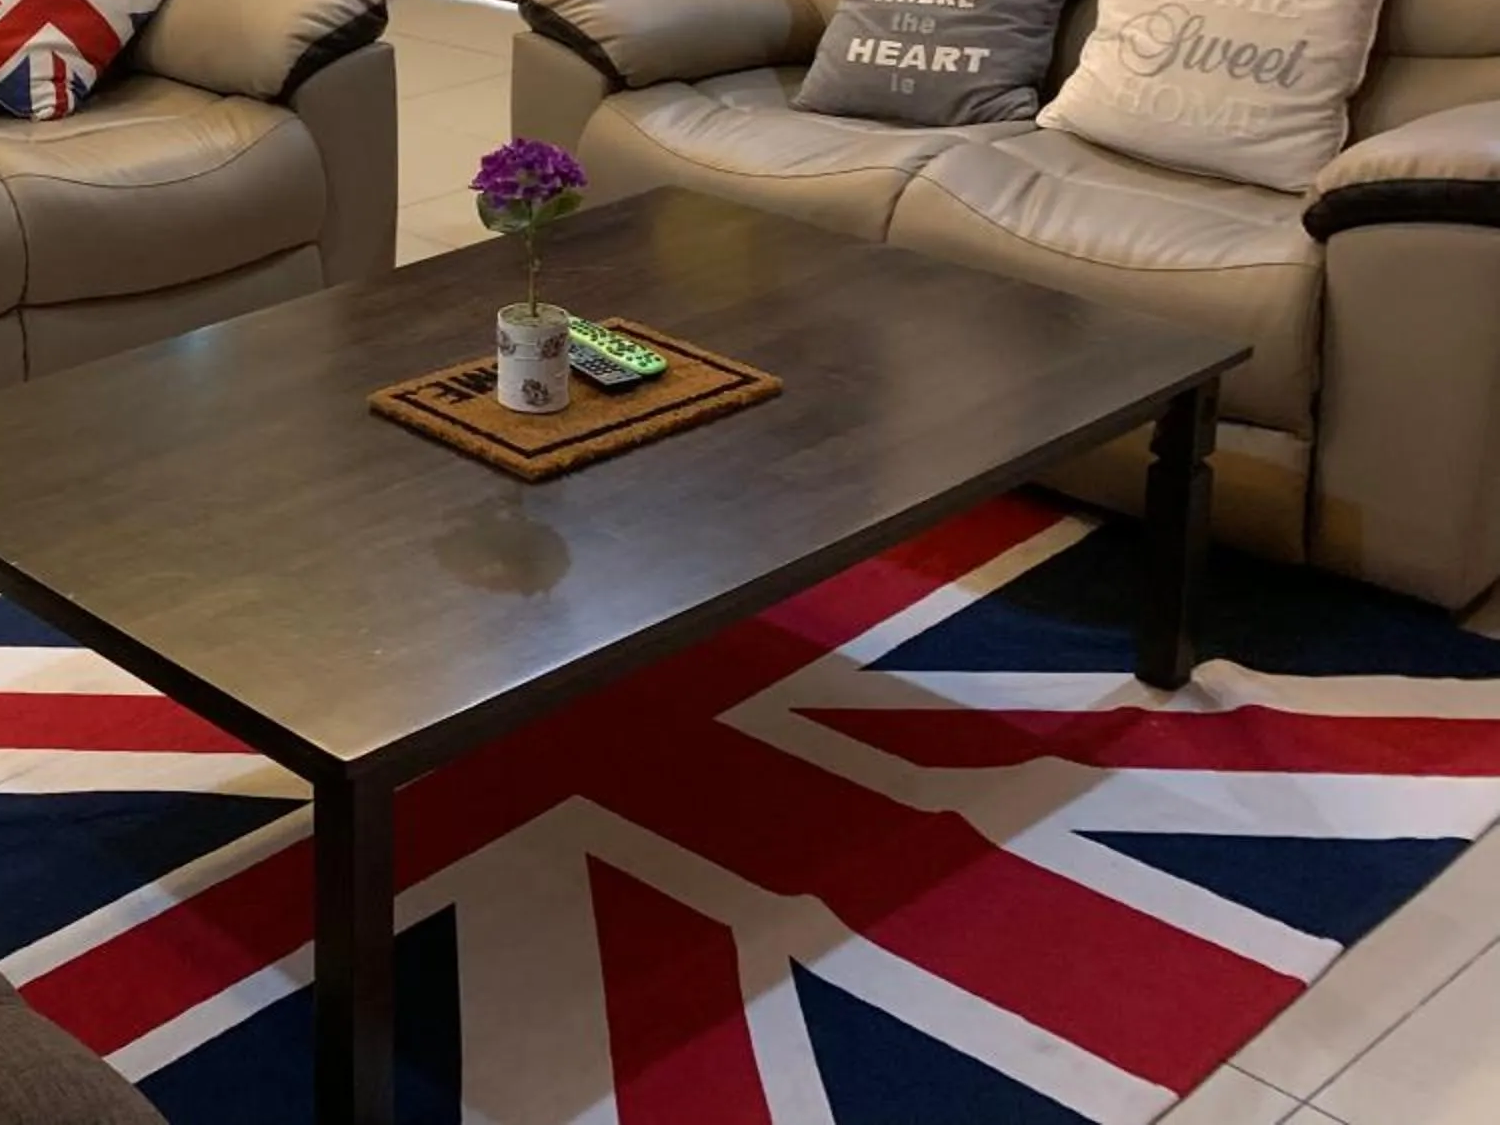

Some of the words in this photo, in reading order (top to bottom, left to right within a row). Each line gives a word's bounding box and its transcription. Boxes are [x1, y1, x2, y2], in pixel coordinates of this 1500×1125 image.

[891, 12, 936, 29] the
[846, 37, 991, 73] HEART
[1117, 2, 1308, 88] Sweet
